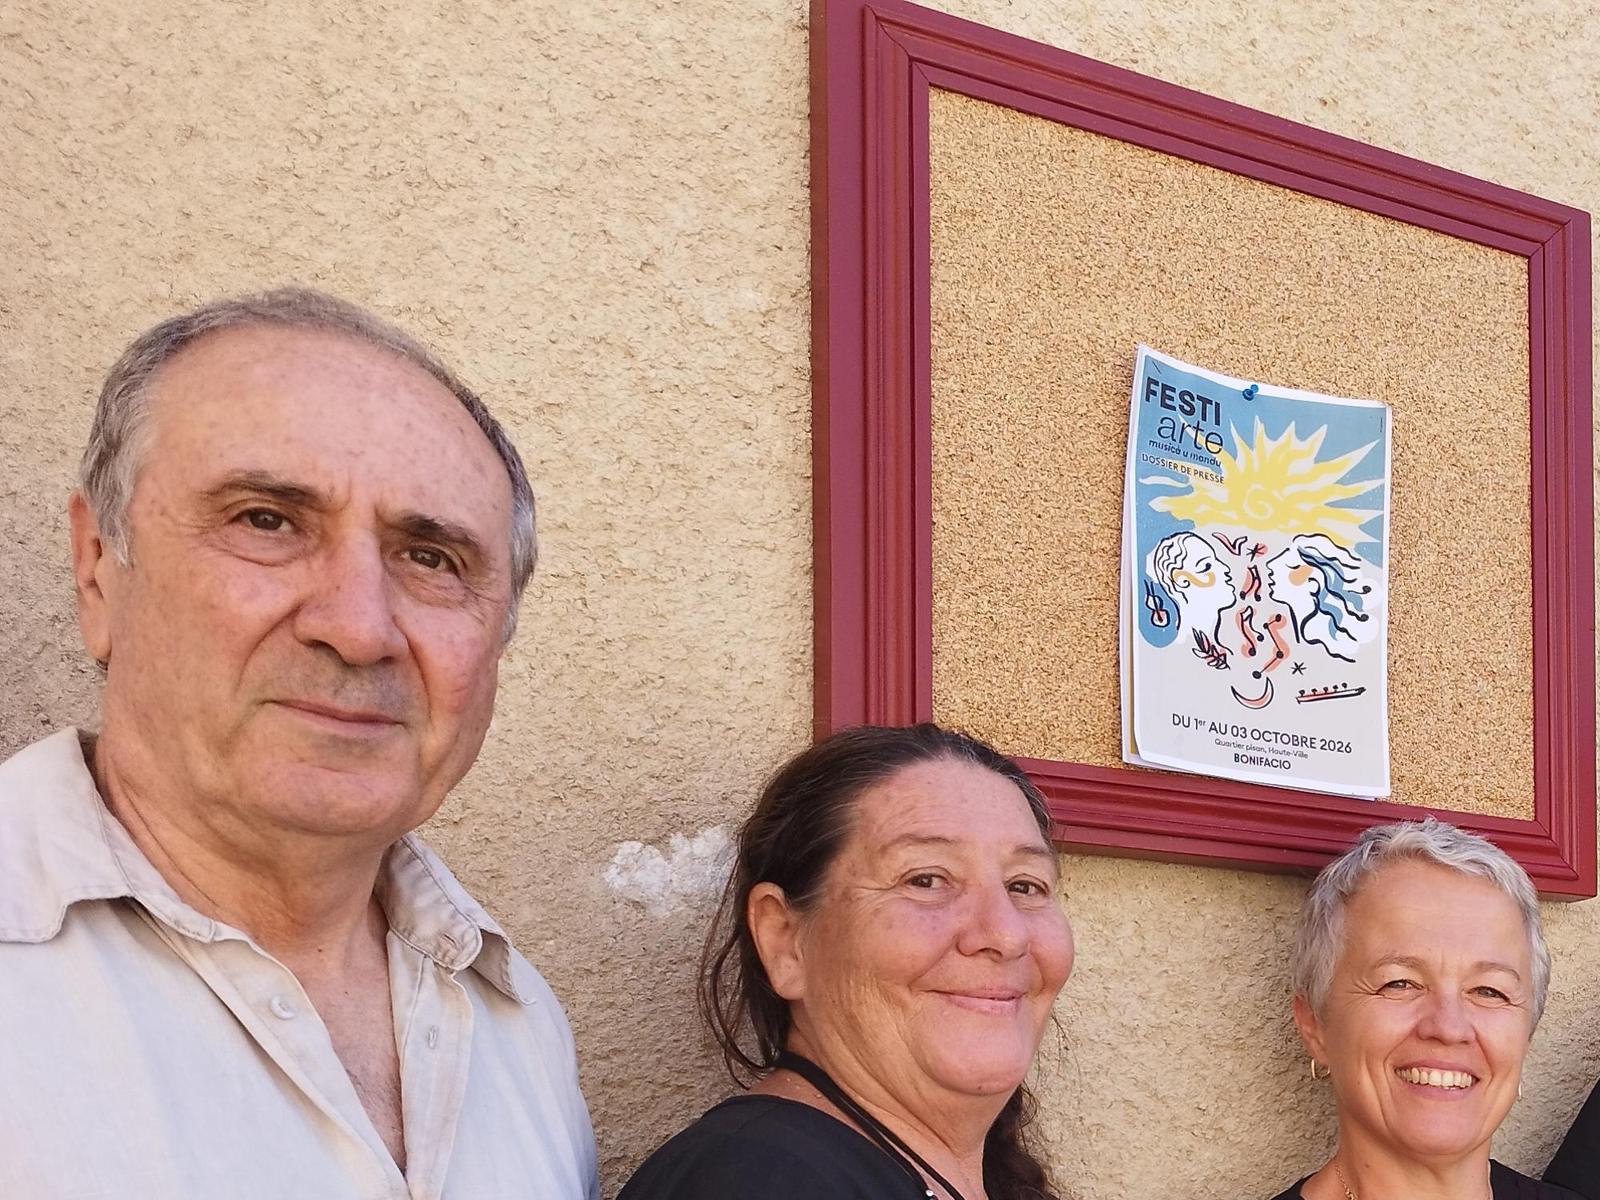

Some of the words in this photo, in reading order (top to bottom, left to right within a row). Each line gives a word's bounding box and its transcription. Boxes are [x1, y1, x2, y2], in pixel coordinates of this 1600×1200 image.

[1145, 376, 1221, 427] FESTI
[1157, 415, 1224, 455] arte
[1142, 453, 1179, 473] DOSSIER
[1180, 465, 1192, 476] DE
[1193, 469, 1225, 484] PRESSE
[1183, 450, 1189, 458] u
[1190, 451, 1222, 469] mondu
[1172, 713, 1191, 729] DU
[1208, 721, 1228, 736] AU
[1231, 725, 1248, 739] 03
[1250, 728, 1317, 750] OCTOBRE
[1319, 738, 1353, 754] 2026
[1214, 738, 1245, 750] Quartier
[1233, 753, 1292, 770] BONIFACIO
